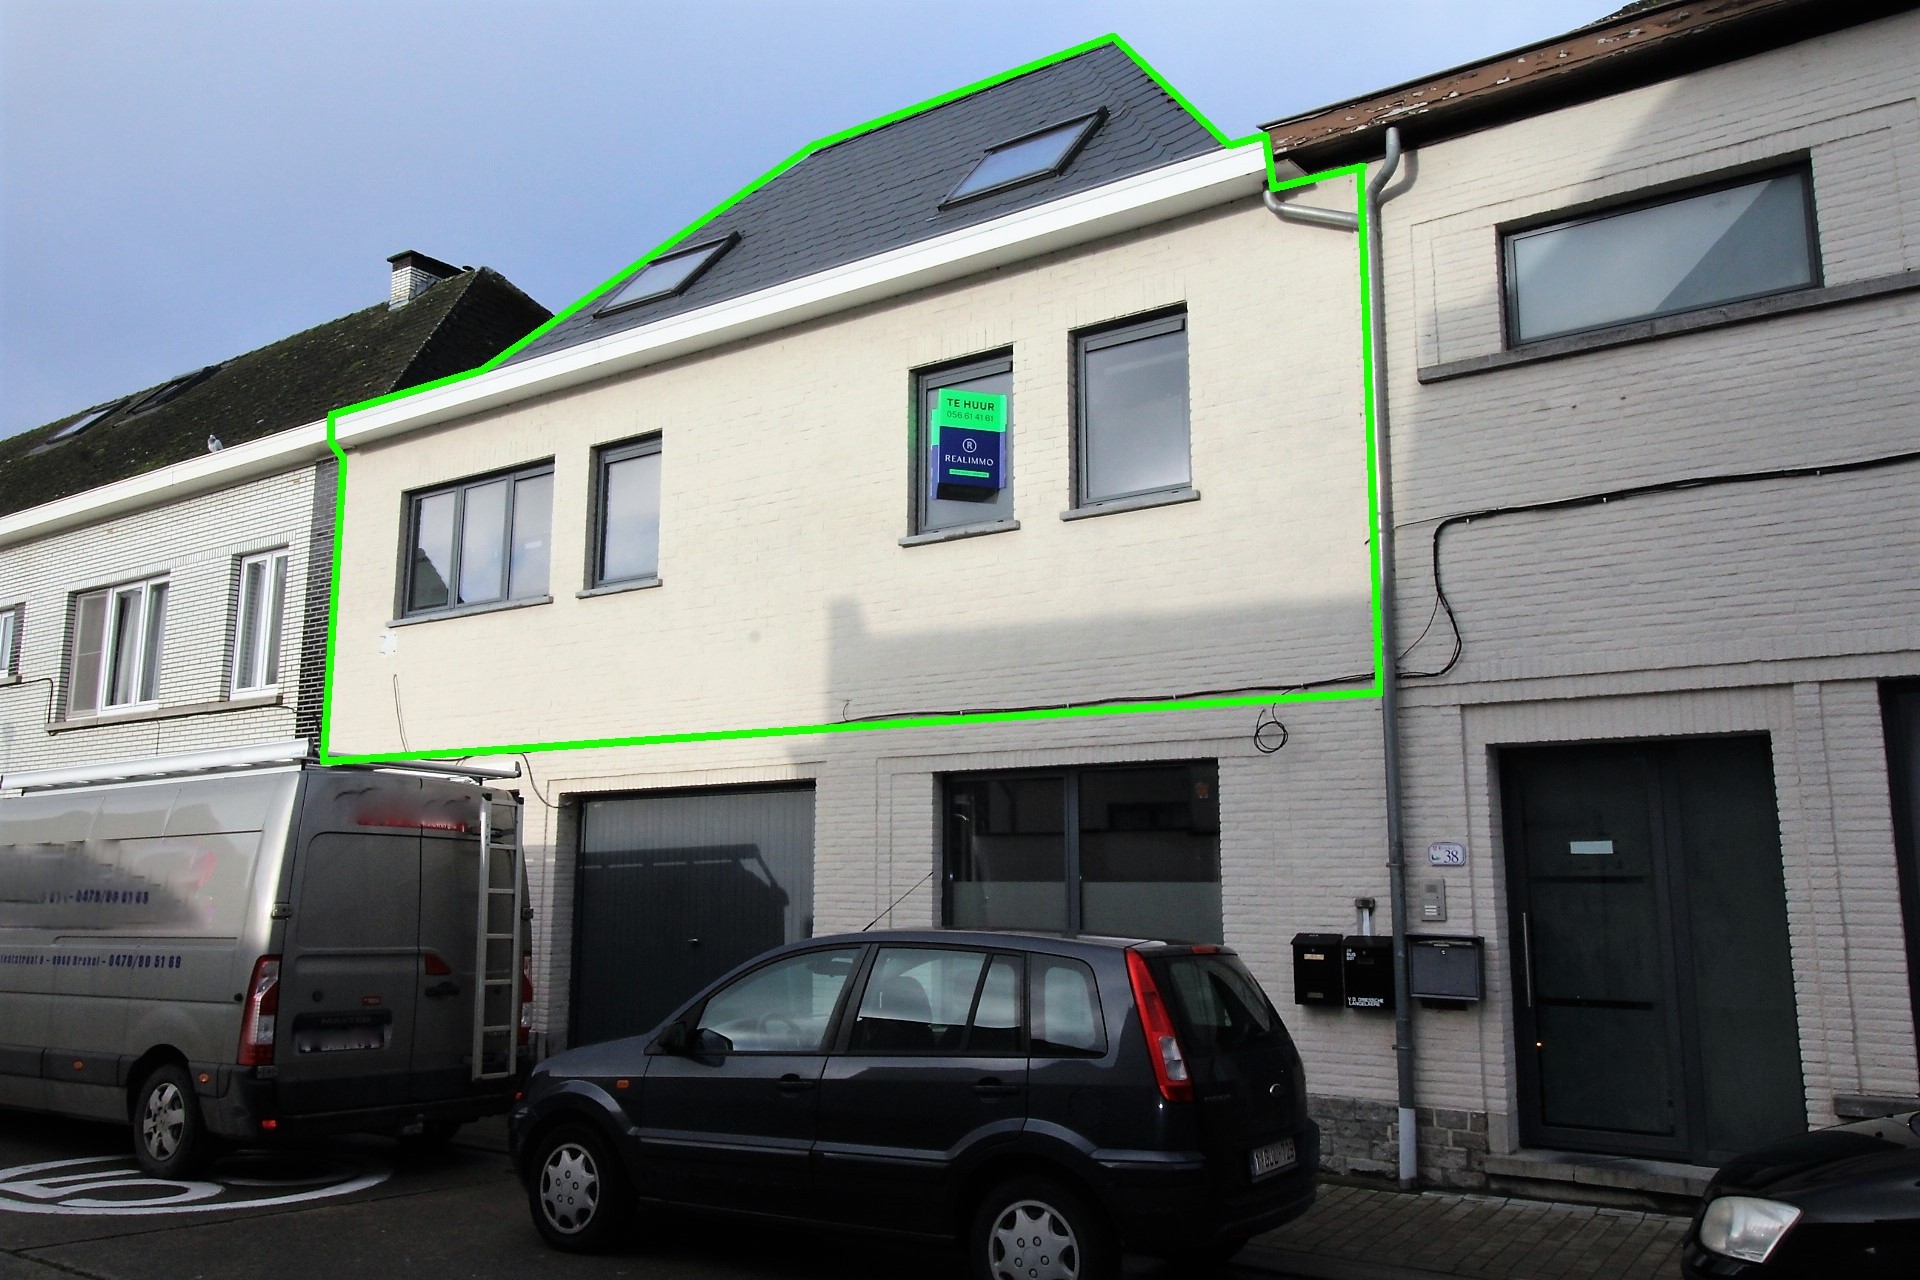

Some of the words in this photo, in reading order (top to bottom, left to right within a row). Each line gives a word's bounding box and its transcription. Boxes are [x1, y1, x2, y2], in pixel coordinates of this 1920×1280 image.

[947, 398, 960, 407] TE
[964, 400, 995, 411] HUUR
[946, 410, 963, 419] 056
[964, 412, 973, 420] 61
[975, 413, 983, 421] 41
[945, 454, 994, 467] REALIMMO
[1444, 849, 1459, 863] 38
